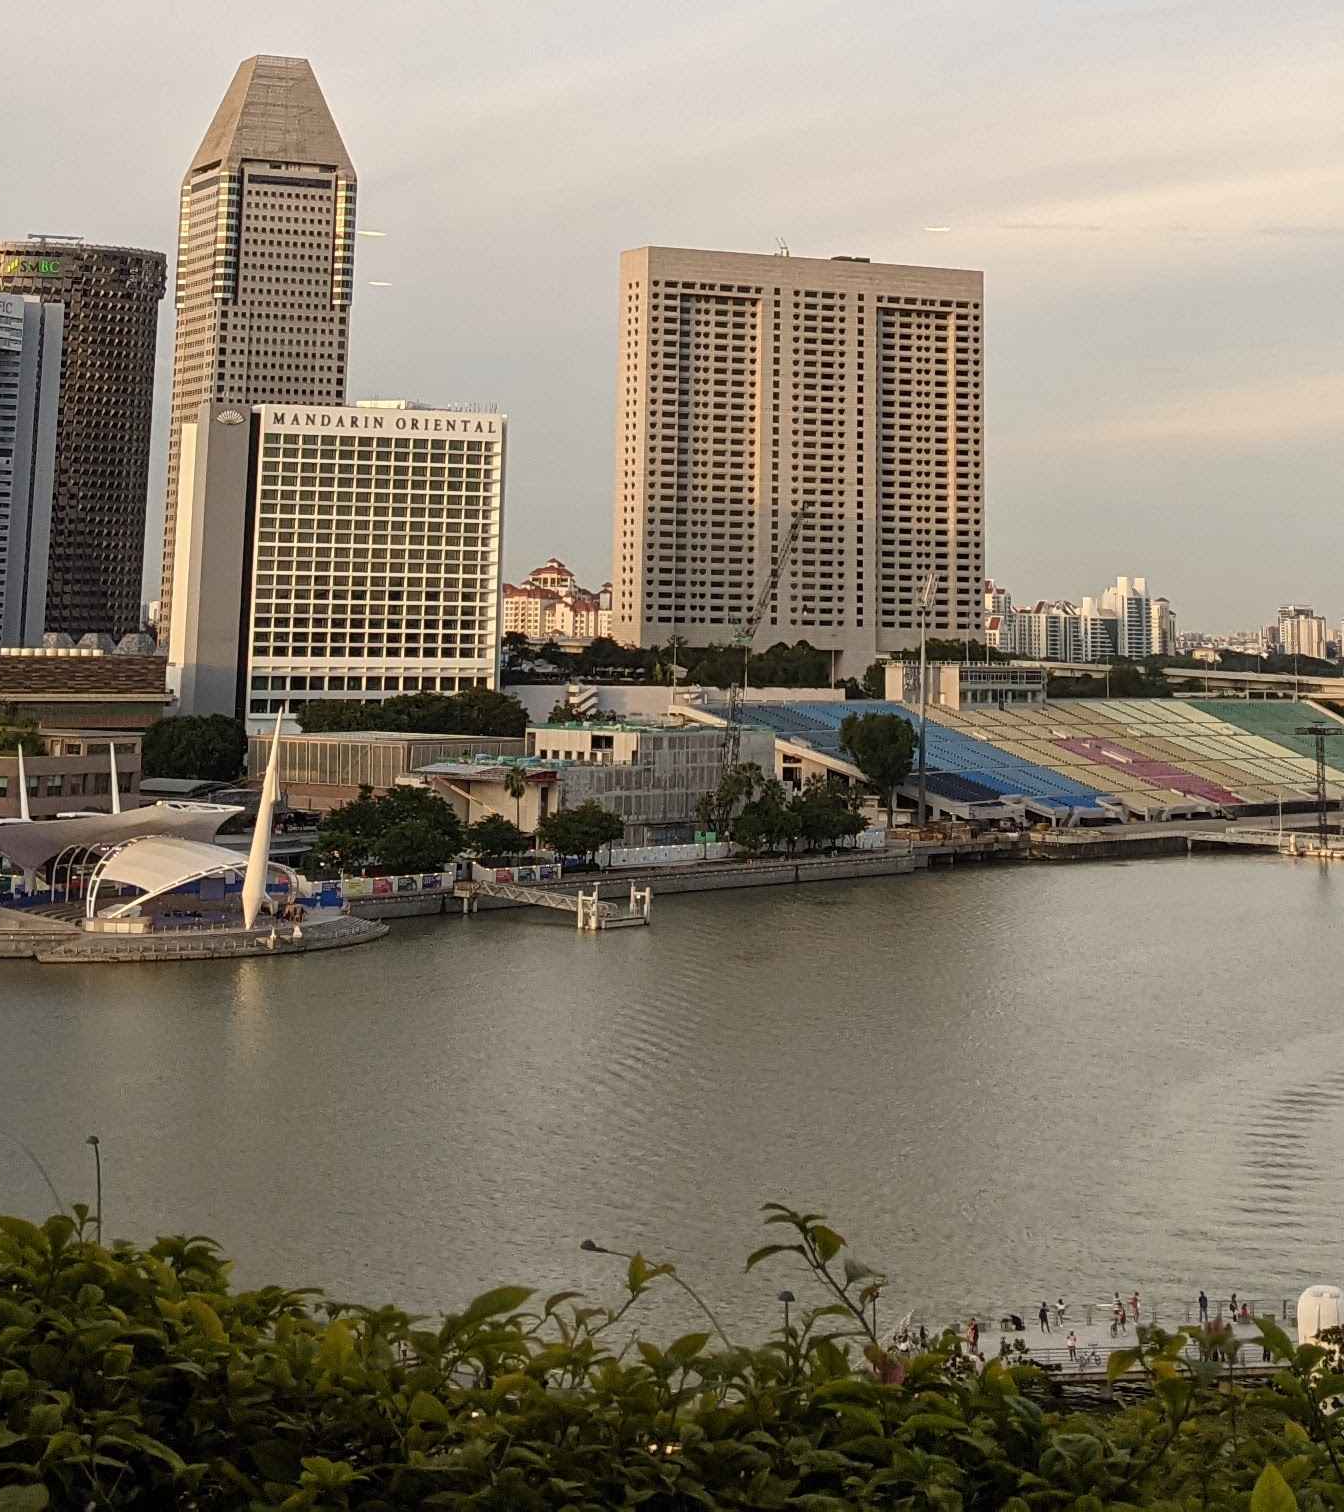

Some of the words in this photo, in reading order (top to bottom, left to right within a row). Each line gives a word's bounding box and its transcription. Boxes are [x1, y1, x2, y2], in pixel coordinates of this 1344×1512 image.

[20, 259, 60, 273] SMBC
[272, 412, 385, 430] MANDARIN
[396, 417, 497, 434] ORIENTAL
